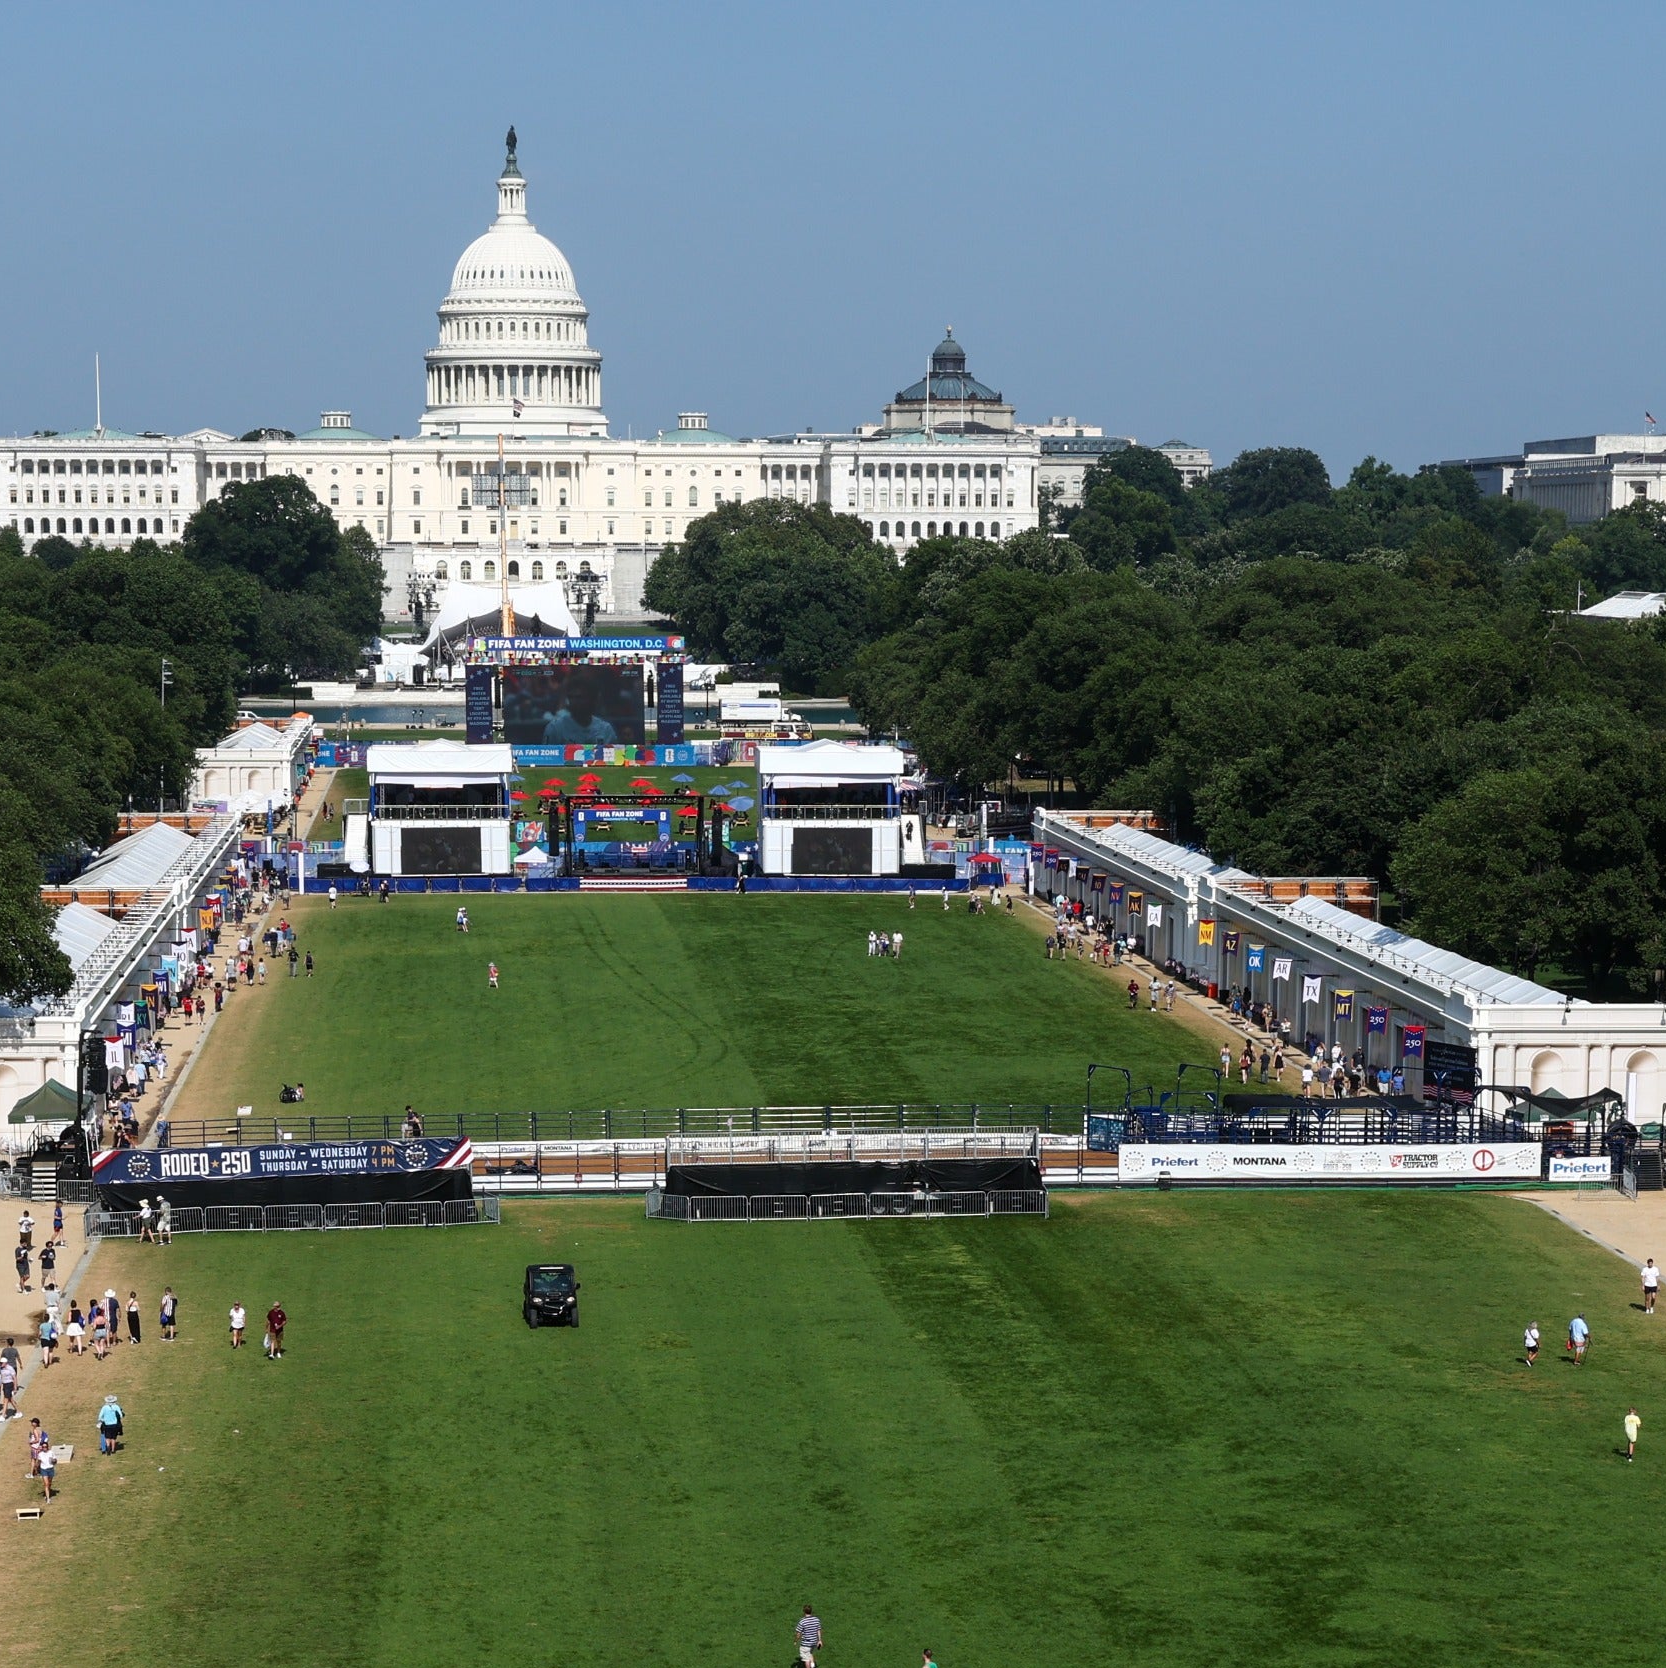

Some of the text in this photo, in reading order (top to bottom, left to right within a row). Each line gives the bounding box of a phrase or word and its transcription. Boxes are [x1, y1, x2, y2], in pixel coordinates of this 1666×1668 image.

[488, 639, 665, 649] FIFA FAN ZONE WASHINGTON, D.C.
[1110, 892, 1120, 900] NV
[1130, 901, 1140, 912] AK
[202, 916, 212, 925] NJ
[1149, 912, 1158, 921] CA
[1200, 930, 1212, 942] NM
[1226, 940, 1236, 950] AZ
[1248, 956, 1260, 967] OK
[1276, 964, 1288, 974] AR
[1306, 986, 1318, 996] TX
[1337, 1003, 1351, 1015] MT
[136, 1013, 147, 1025] KY
[1370, 1014, 1384, 1024] 250
[121, 1032, 132, 1046] MI
[1405, 1038, 1421, 1048] 250
[111, 1052, 119, 1062] IL
[259, 1148, 297, 1161] SUNDAY
[310, 1146, 368, 1158] WEDNESDAY
[371, 1146, 378, 1156] 7
[380, 1145, 395, 1156] PM
[161, 1150, 251, 1177] RODEO 250
[260, 1160, 308, 1173] THURSDAY
[321, 1158, 369, 1170] SATURDAY
[371, 1158, 378, 1168] 4
[381, 1156, 396, 1168] PM
[1152, 1156, 1198, 1166] Priefert
[1233, 1157, 1286, 1166] MONTANA
[1553, 1162, 1607, 1174] Priefert
